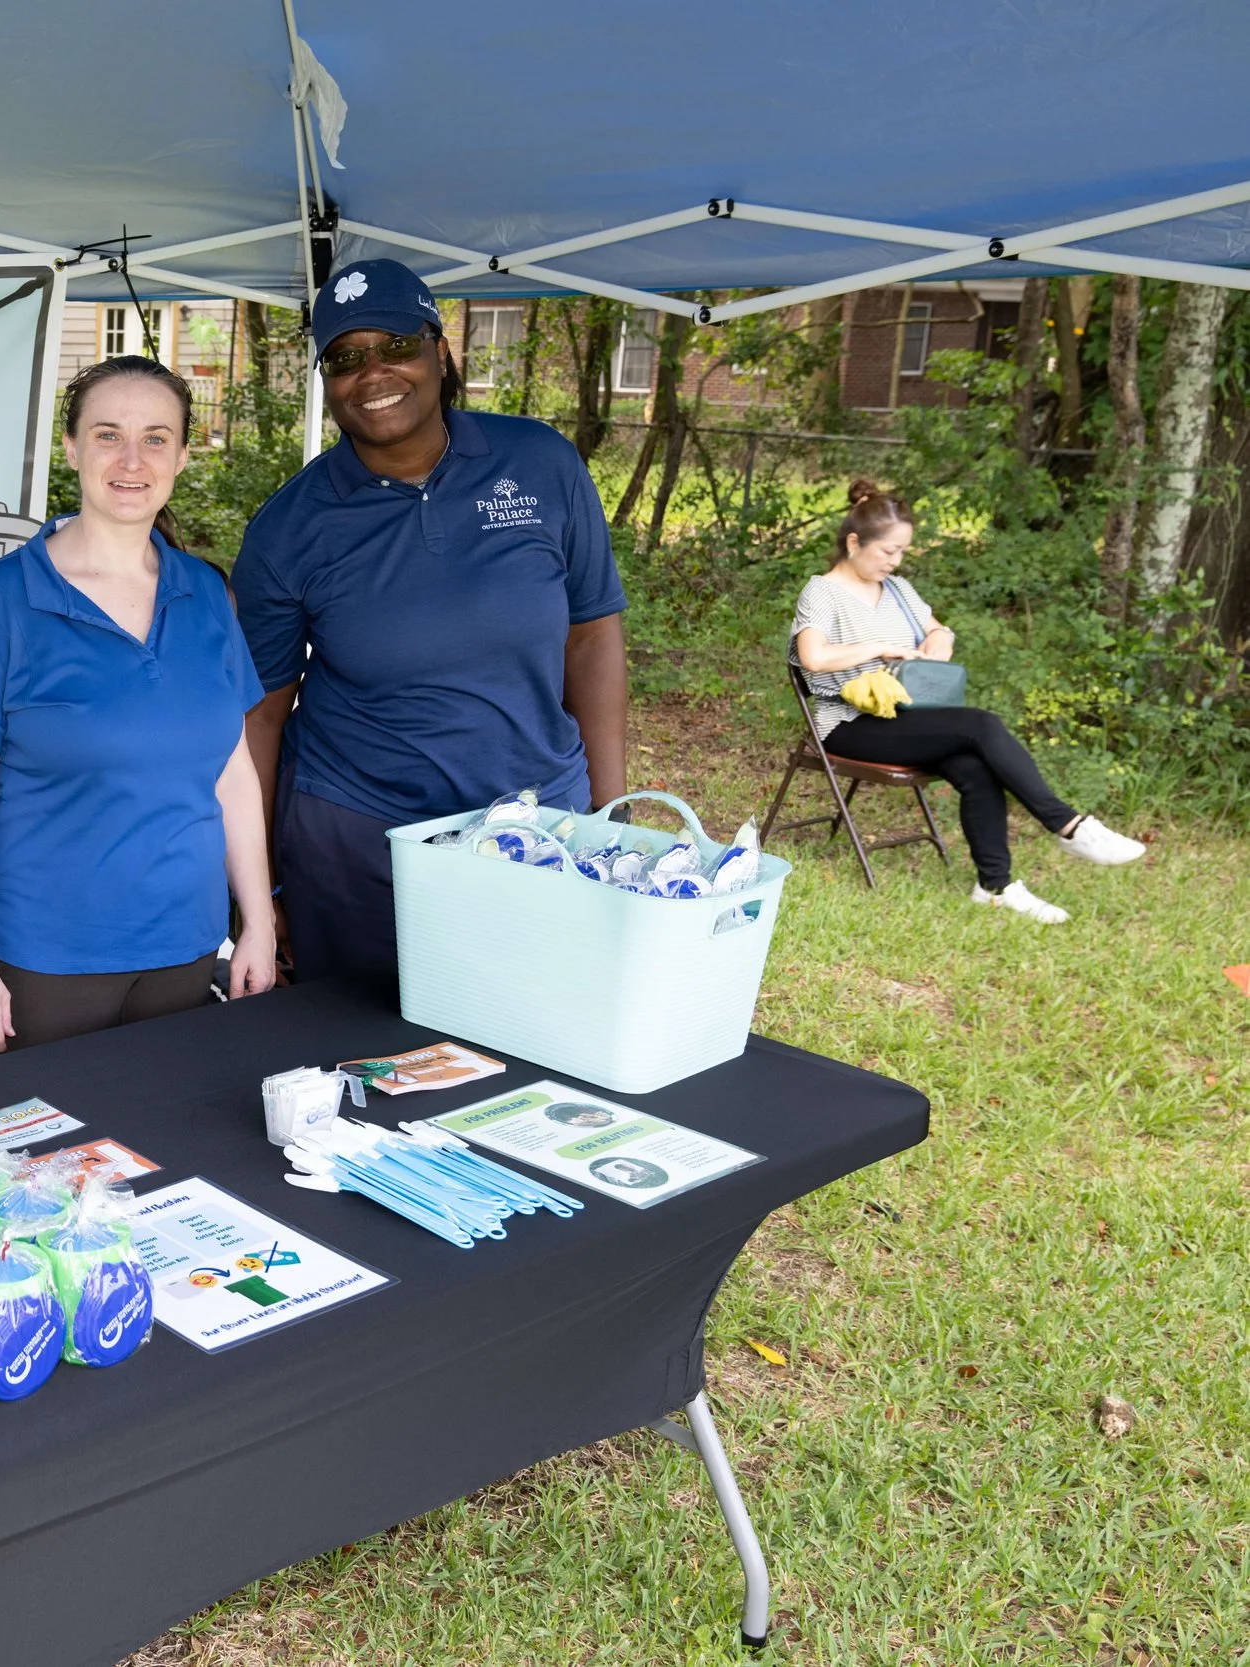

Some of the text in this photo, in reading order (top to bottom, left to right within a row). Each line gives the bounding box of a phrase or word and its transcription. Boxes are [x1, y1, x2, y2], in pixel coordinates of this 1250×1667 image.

[476, 495, 538, 512] Palmetto
[488, 508, 533, 523] Palace
[481, 521, 515, 530] OUTREACH
[463, 1098, 532, 1124] FOG PROBLEMS
[575, 1125, 644, 1153] FOG SOLUTIONS
[27, 1161, 48, 1173] LOG
[179, 1214, 203, 1223] Diapers
[195, 1223, 219, 1233] Dreams
[195, 1225, 235, 1241] Cotton Swabs
[200, 1273, 364, 1337] Our Sewer Lines are Highly Sensitive!
